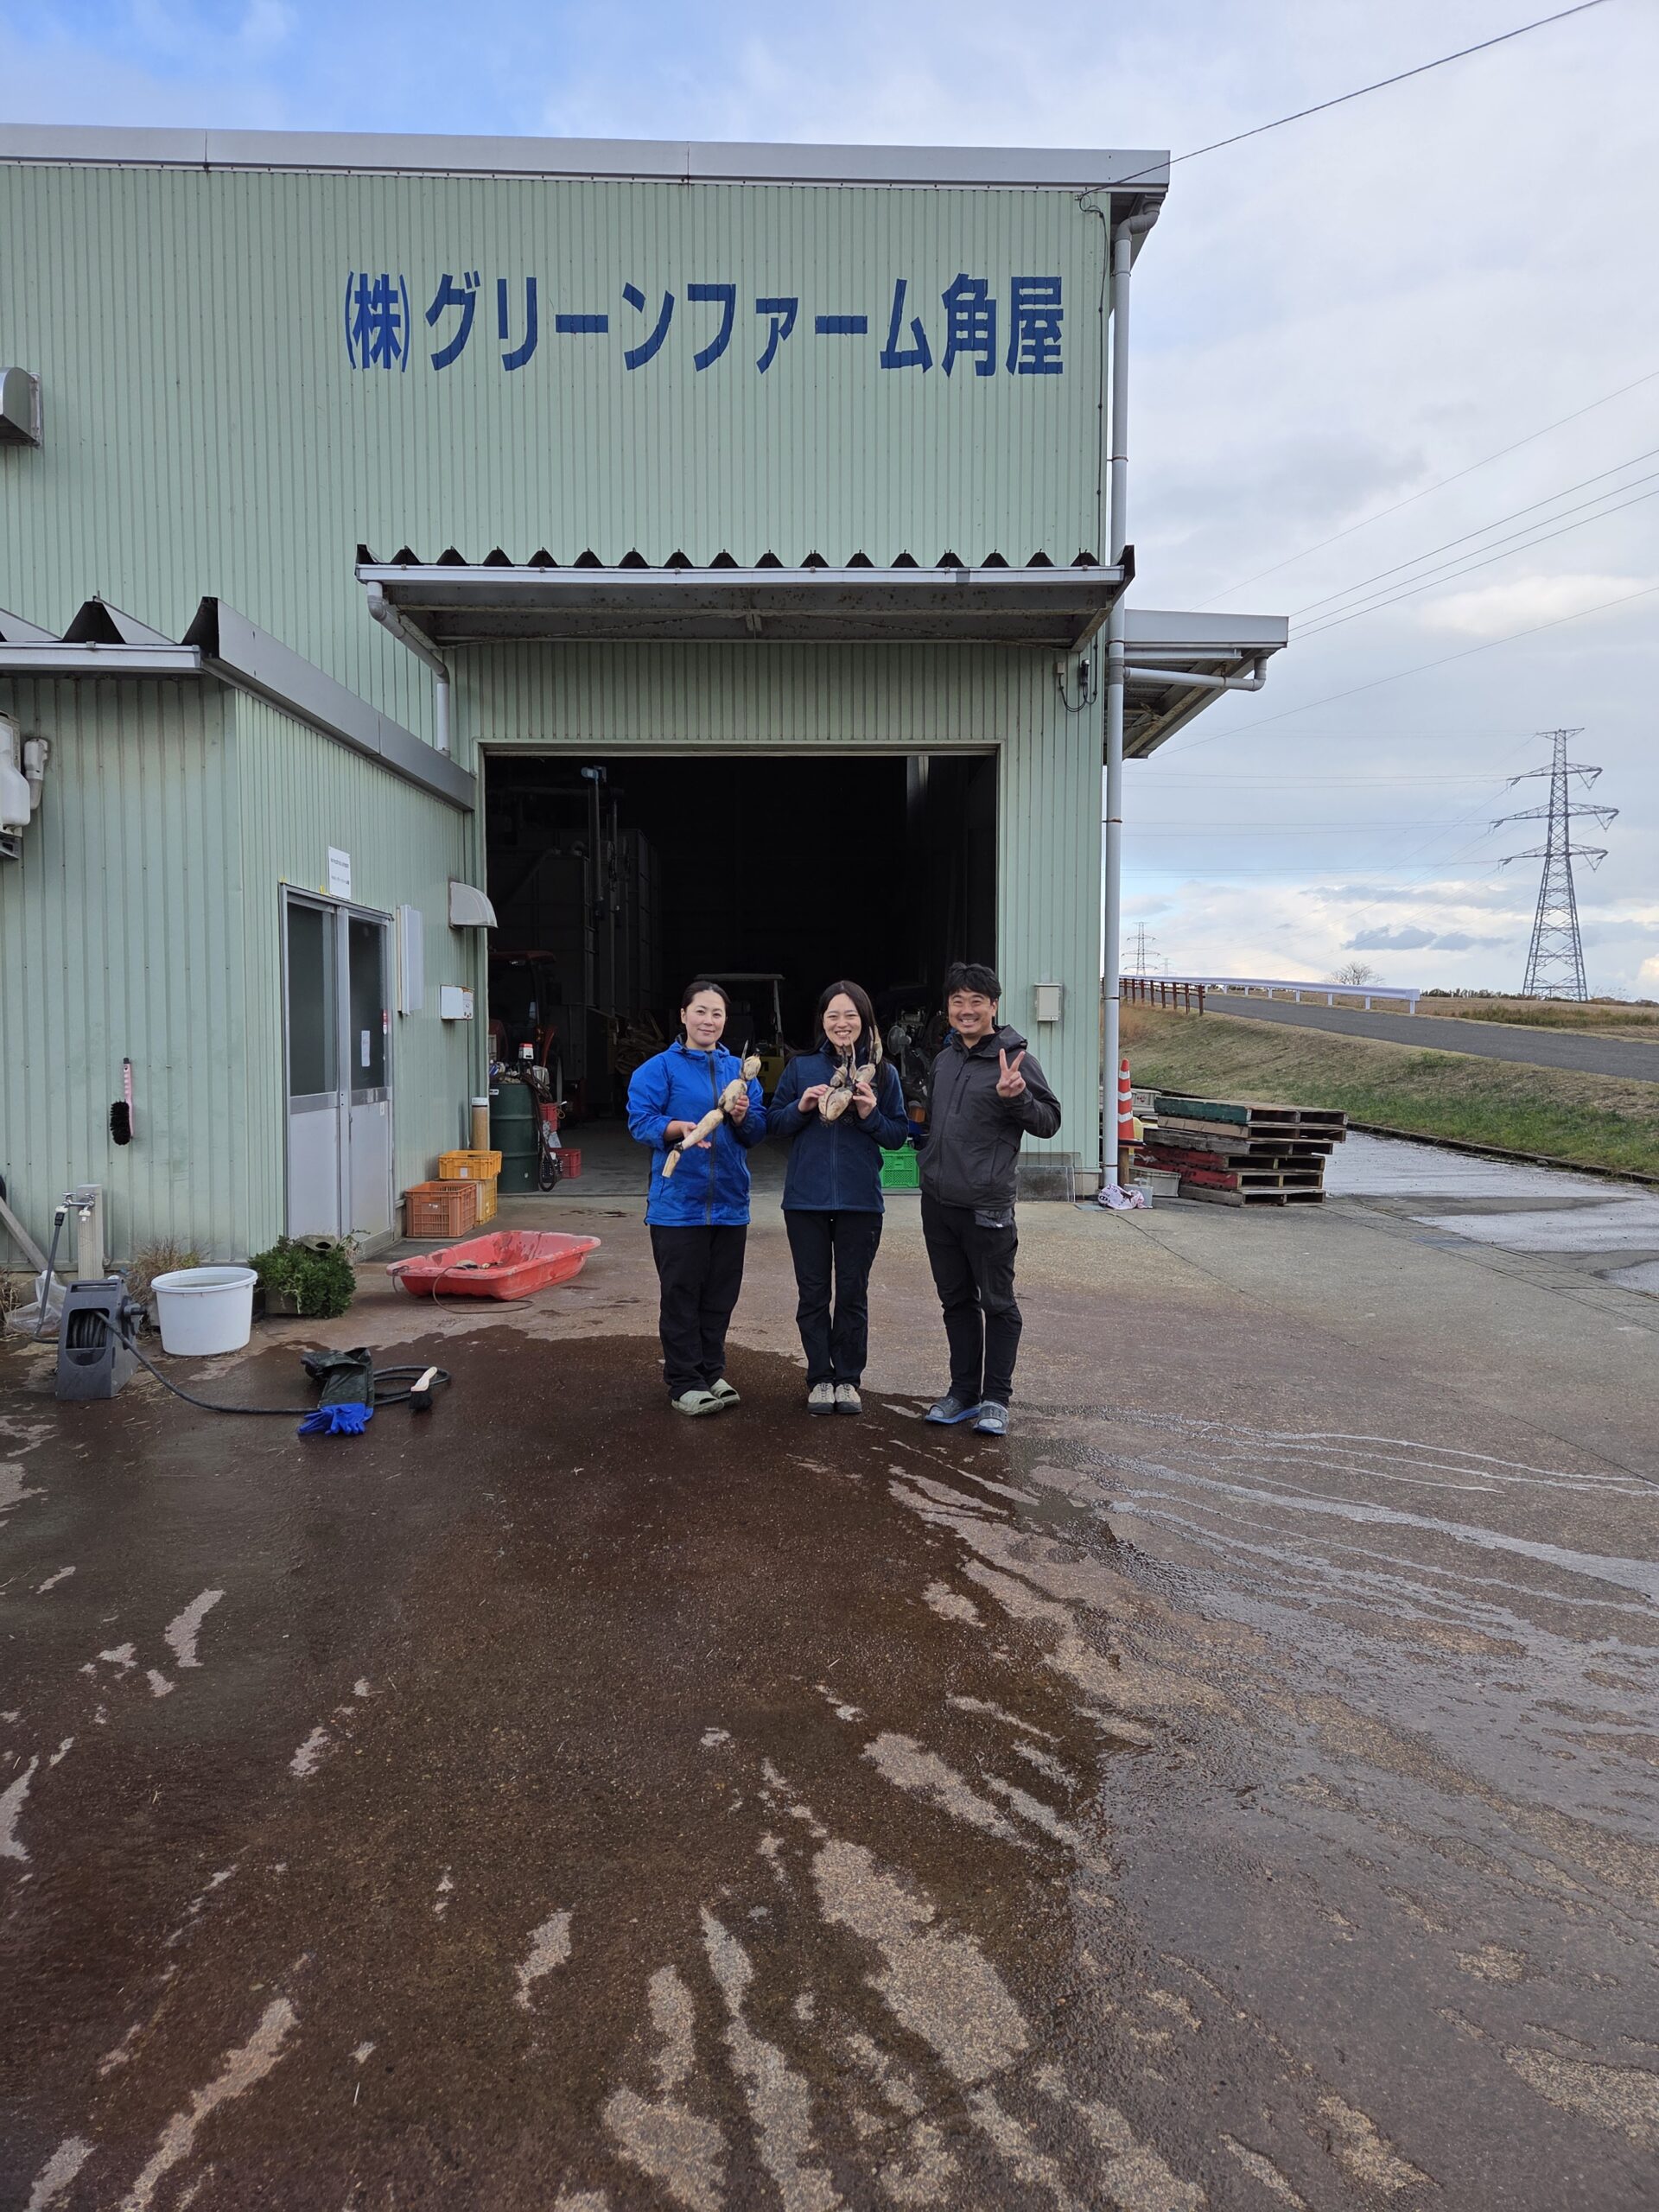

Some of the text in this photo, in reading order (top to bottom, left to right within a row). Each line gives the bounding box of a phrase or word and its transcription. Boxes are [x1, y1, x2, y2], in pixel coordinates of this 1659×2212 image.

[346, 271, 1064, 377] (株)グリーンファーム角屋
